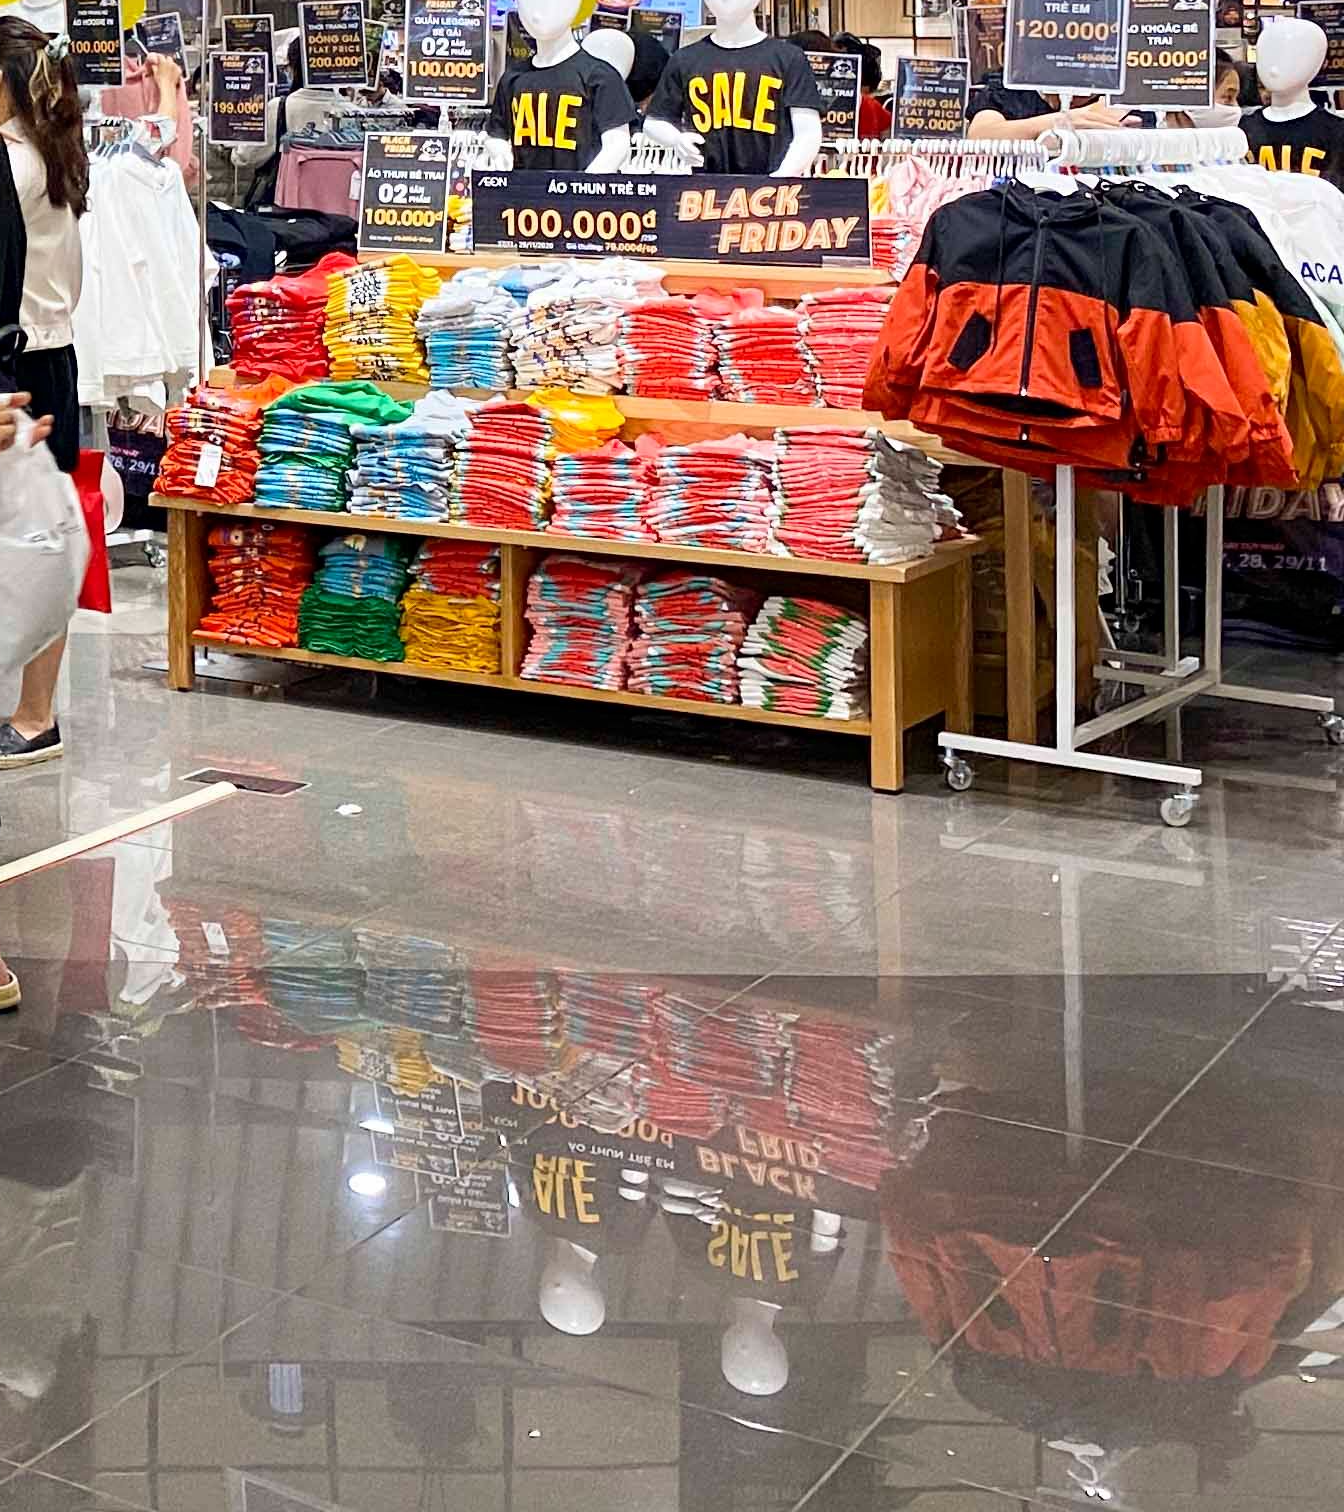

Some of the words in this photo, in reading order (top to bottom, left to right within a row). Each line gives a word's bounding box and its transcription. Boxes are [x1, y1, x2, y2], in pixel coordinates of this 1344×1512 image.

[1072, 3, 1091, 14] EM
[1127, 24, 1139, 34] O
[1140, 21, 1181, 34] KHOÁC
[341, 31, 361, 43] GIÁ
[1147, 36, 1173, 46] TRAI
[308, 45, 330, 54] FLAT
[333, 45, 361, 54] PRICE
[421, 36, 450, 56] 02
[1126, 49, 1208, 68] 50.000đ
[687, 71, 783, 135] SALE
[939, 97, 962, 110] GIÁ
[899, 107, 923, 118] FLAT
[927, 108, 961, 119] PRICE
[512, 91, 583, 151] ALE
[384, 144, 418, 154] FRIDAY
[382, 170, 409, 180] THUN
[423, 170, 445, 181] TRAI
[378, 182, 409, 205] 02
[548, 179, 568, 194] ÁO
[570, 181, 606, 196] THUN
[637, 183, 657, 196] EM
[678, 183, 803, 222] BLACK
[717, 216, 860, 254] FRIDAY
